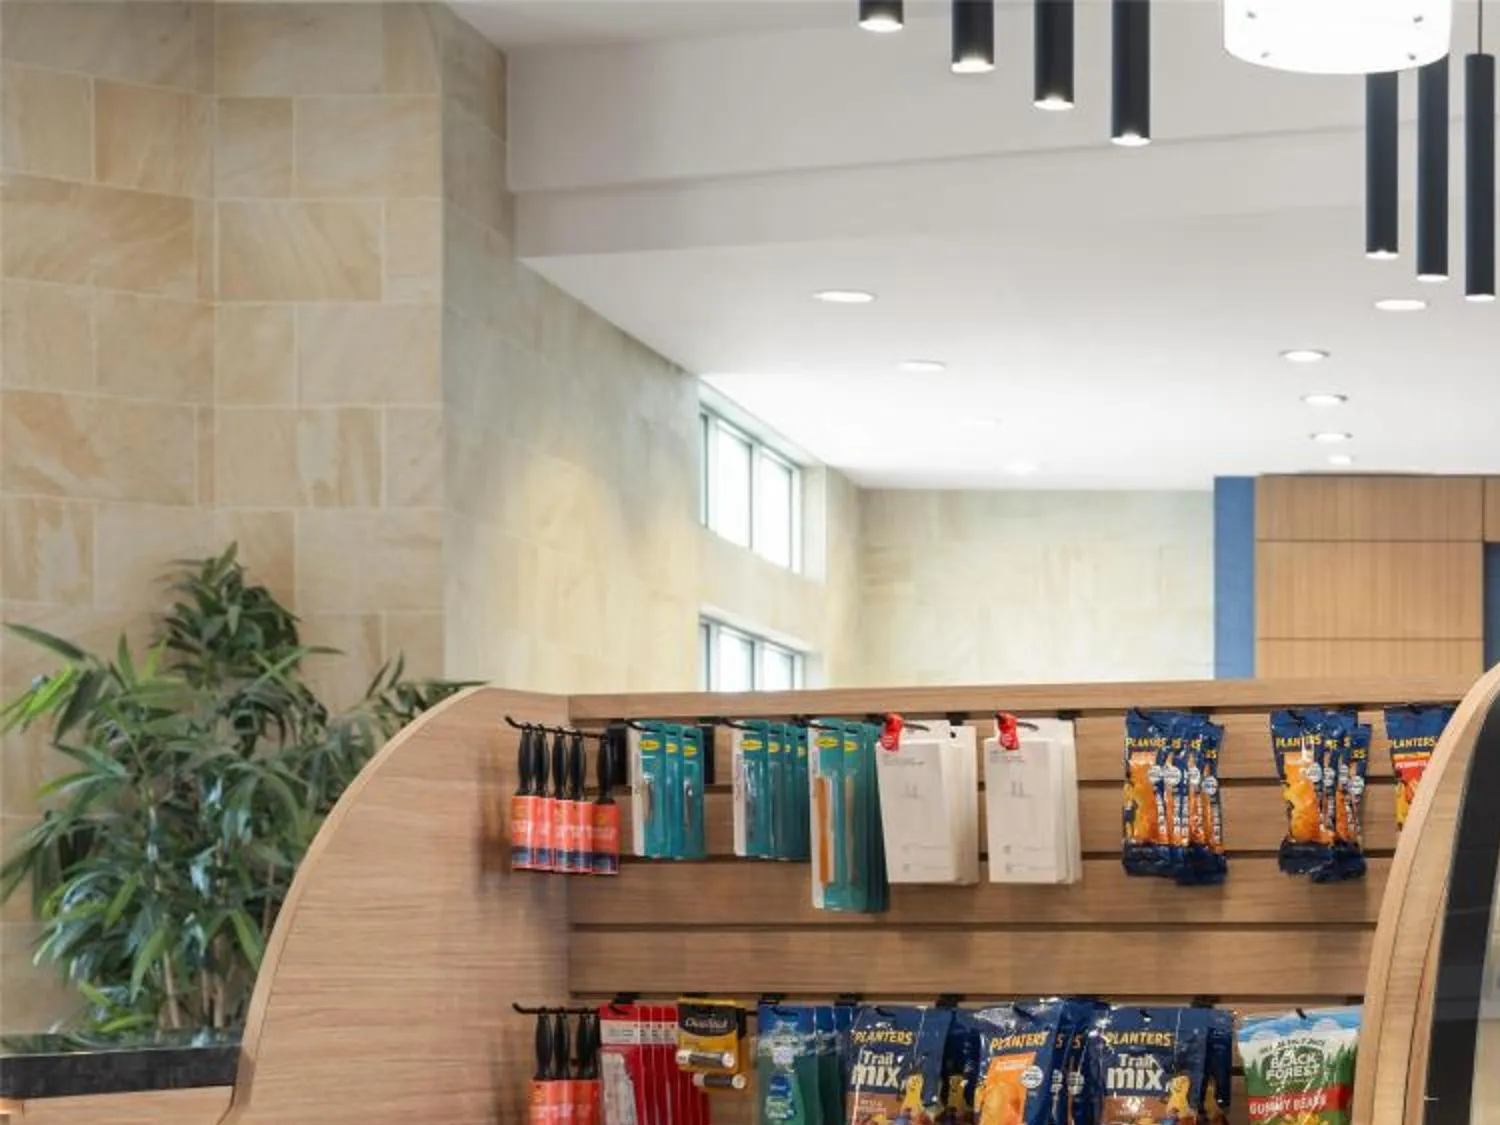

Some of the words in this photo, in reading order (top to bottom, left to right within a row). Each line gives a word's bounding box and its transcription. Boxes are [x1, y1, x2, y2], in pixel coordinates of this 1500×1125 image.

[854, 1030, 914, 1046] PLANTERS
[1104, 1030, 1173, 1047] PLANTERS
[864, 1051, 895, 1066] Trail
[1107, 1067, 1165, 1090] mix
